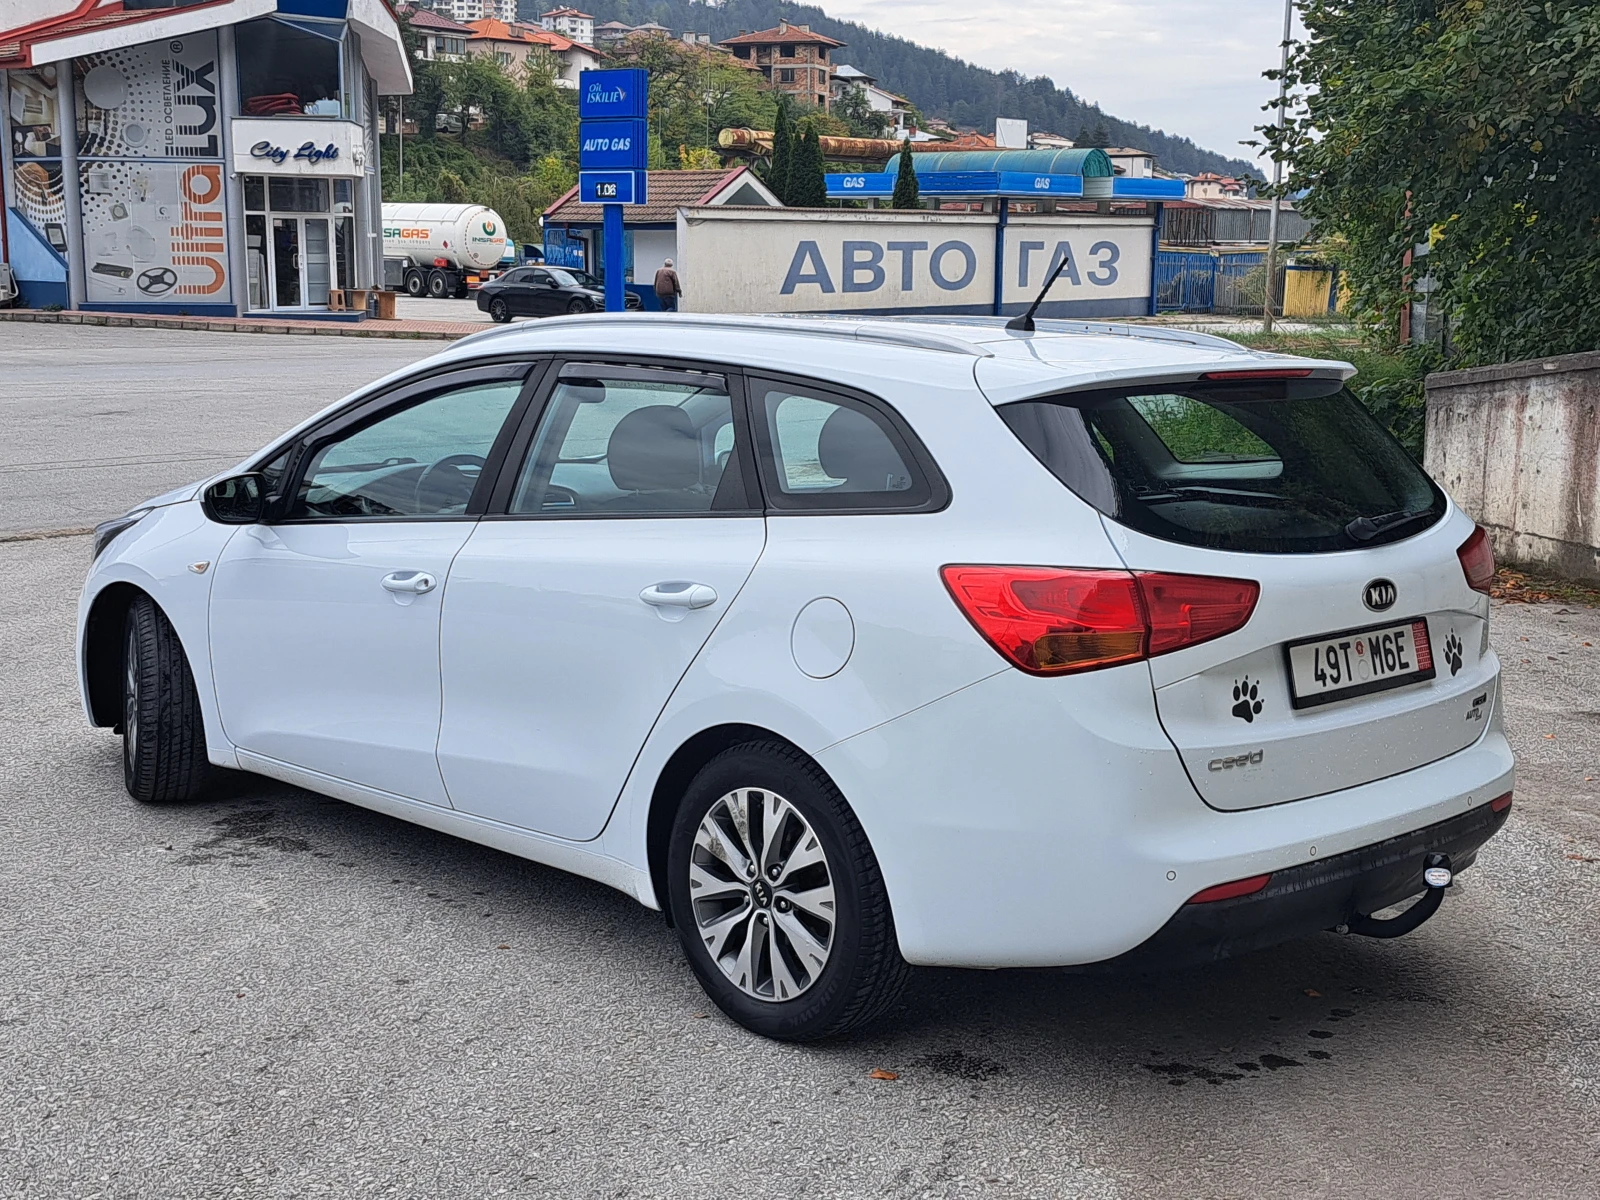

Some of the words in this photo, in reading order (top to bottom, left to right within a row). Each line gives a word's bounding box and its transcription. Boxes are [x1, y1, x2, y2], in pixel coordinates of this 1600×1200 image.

[161, 58, 173, 125] ОСВЕТЛЕНИЕ
[164, 128, 174, 146] LED
[582, 138, 609, 151] AUTO
[610, 137, 631, 151] GAS
[249, 140, 290, 165] City
[293, 141, 340, 165] Light
[843, 176, 866, 188] GAS
[1034, 177, 1051, 189] GAS
[779, 239, 977, 296] АВТО
[1018, 240, 1121, 288] ГАЗ
[1369, 584, 1395, 606] KIA
[1314, 641, 1353, 688] 49T
[1368, 630, 1410, 676] M6E
[754, 881, 768, 907] KIA
